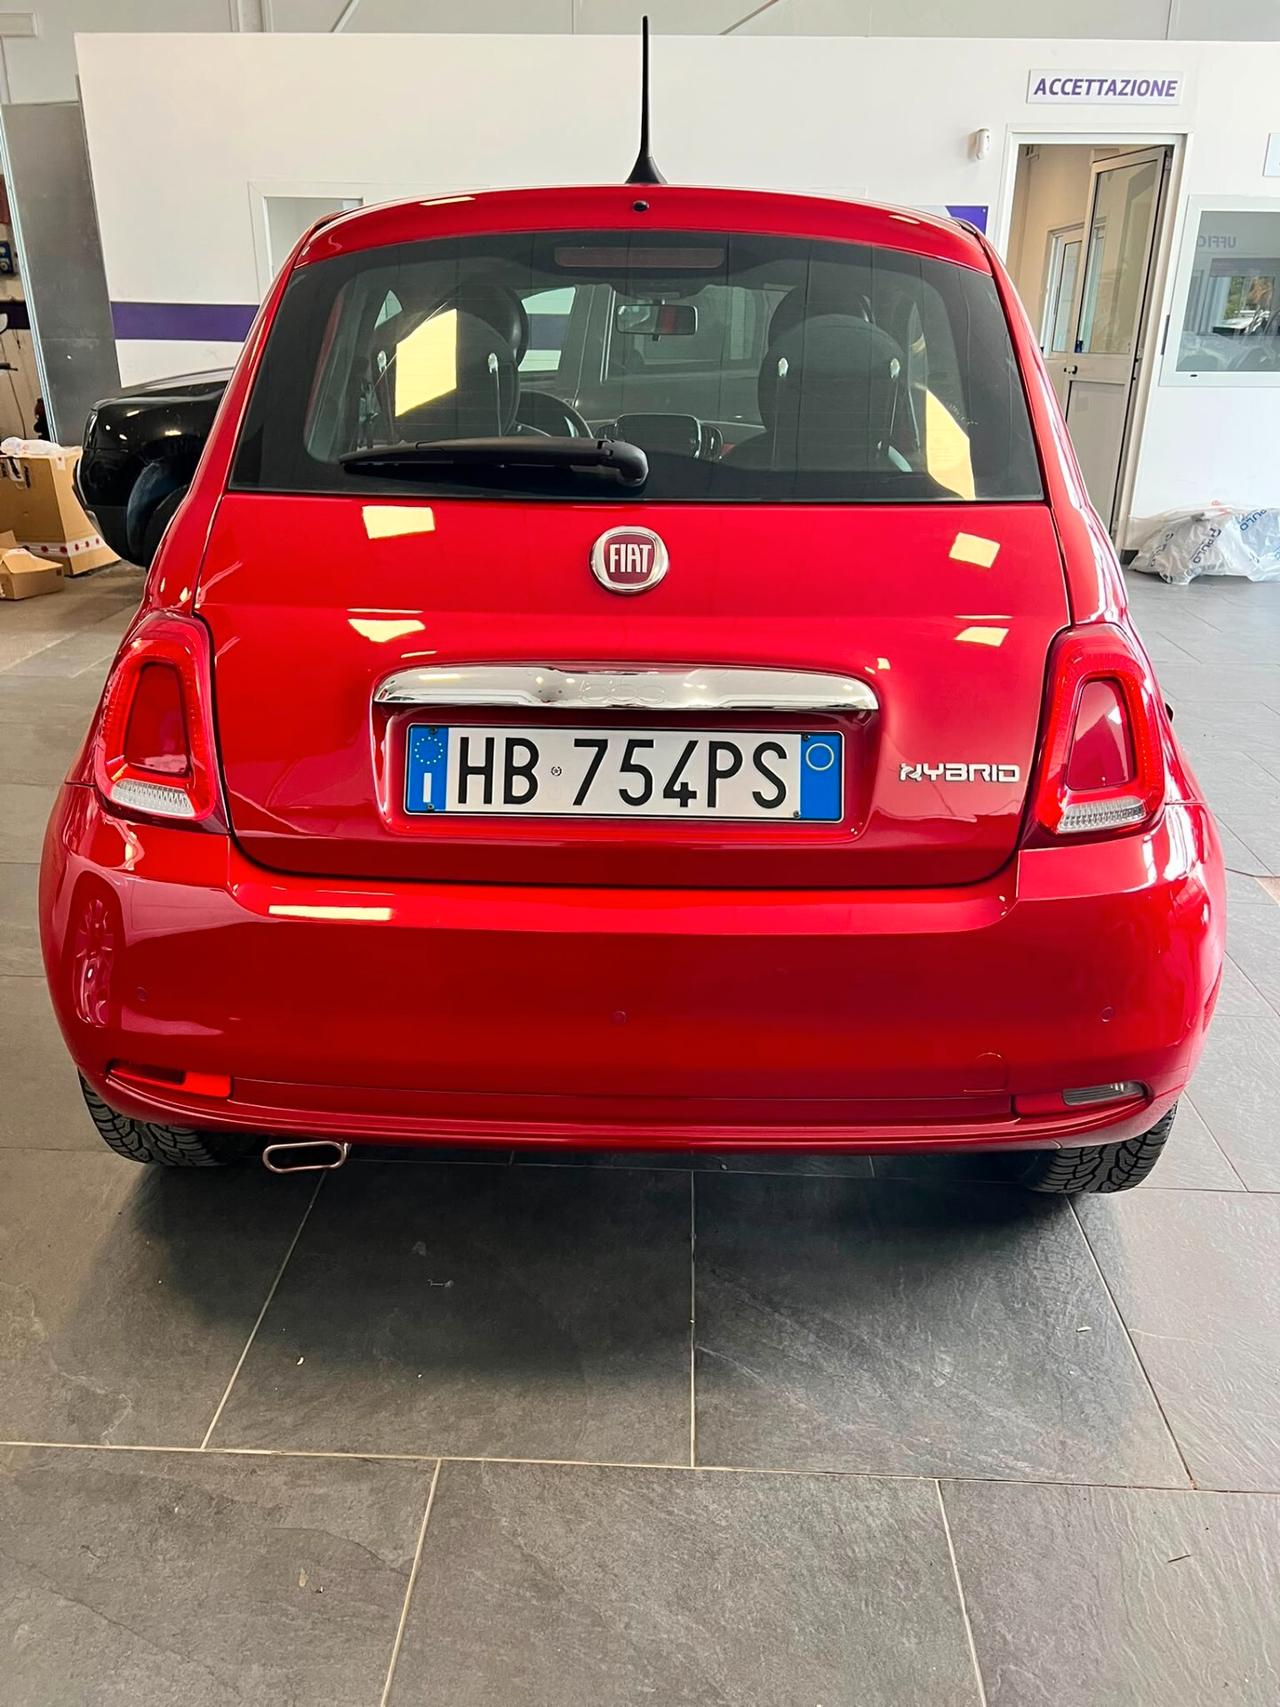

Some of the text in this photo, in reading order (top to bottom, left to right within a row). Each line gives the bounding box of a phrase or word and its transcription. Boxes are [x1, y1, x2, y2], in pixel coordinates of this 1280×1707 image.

[1034, 78, 1178, 97] ACCETTAZIONE
[609, 543, 651, 573] FIAT
[457, 736, 788, 809] HB 754PS
[900, 762, 1020, 782] HYBRID
